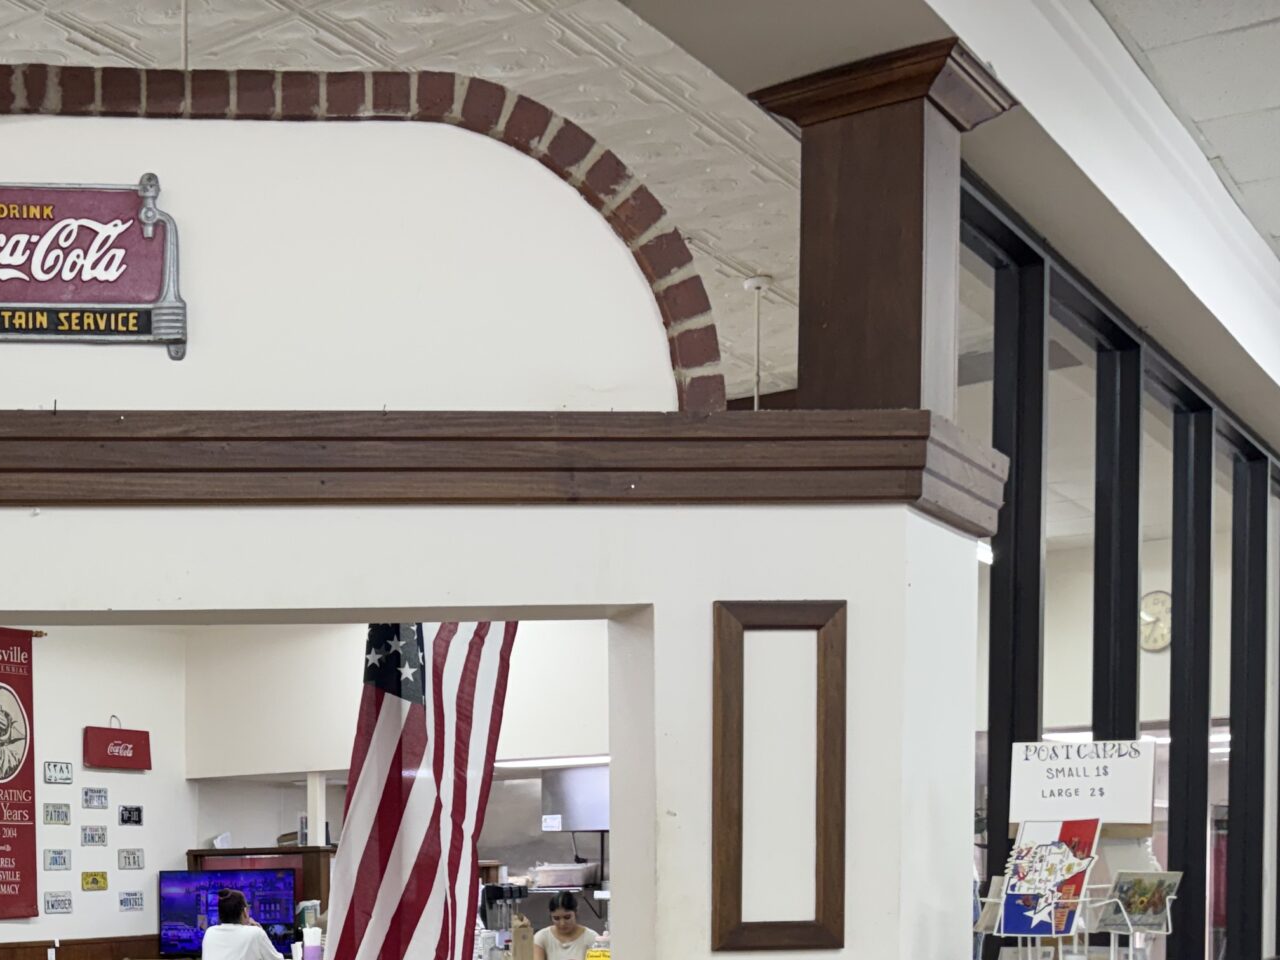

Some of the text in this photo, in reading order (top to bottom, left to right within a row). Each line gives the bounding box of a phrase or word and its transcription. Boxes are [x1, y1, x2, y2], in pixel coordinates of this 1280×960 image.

[57, 312, 138, 331] SERVICE
[1023, 741, 1141, 761] POSTCARDS
[1046, 765, 1109, 779] SMALL 1$
[1041, 788, 1080, 798] LARGE
[1, 802, 29, 820] Years
[2, 828, 17, 838] 2004
